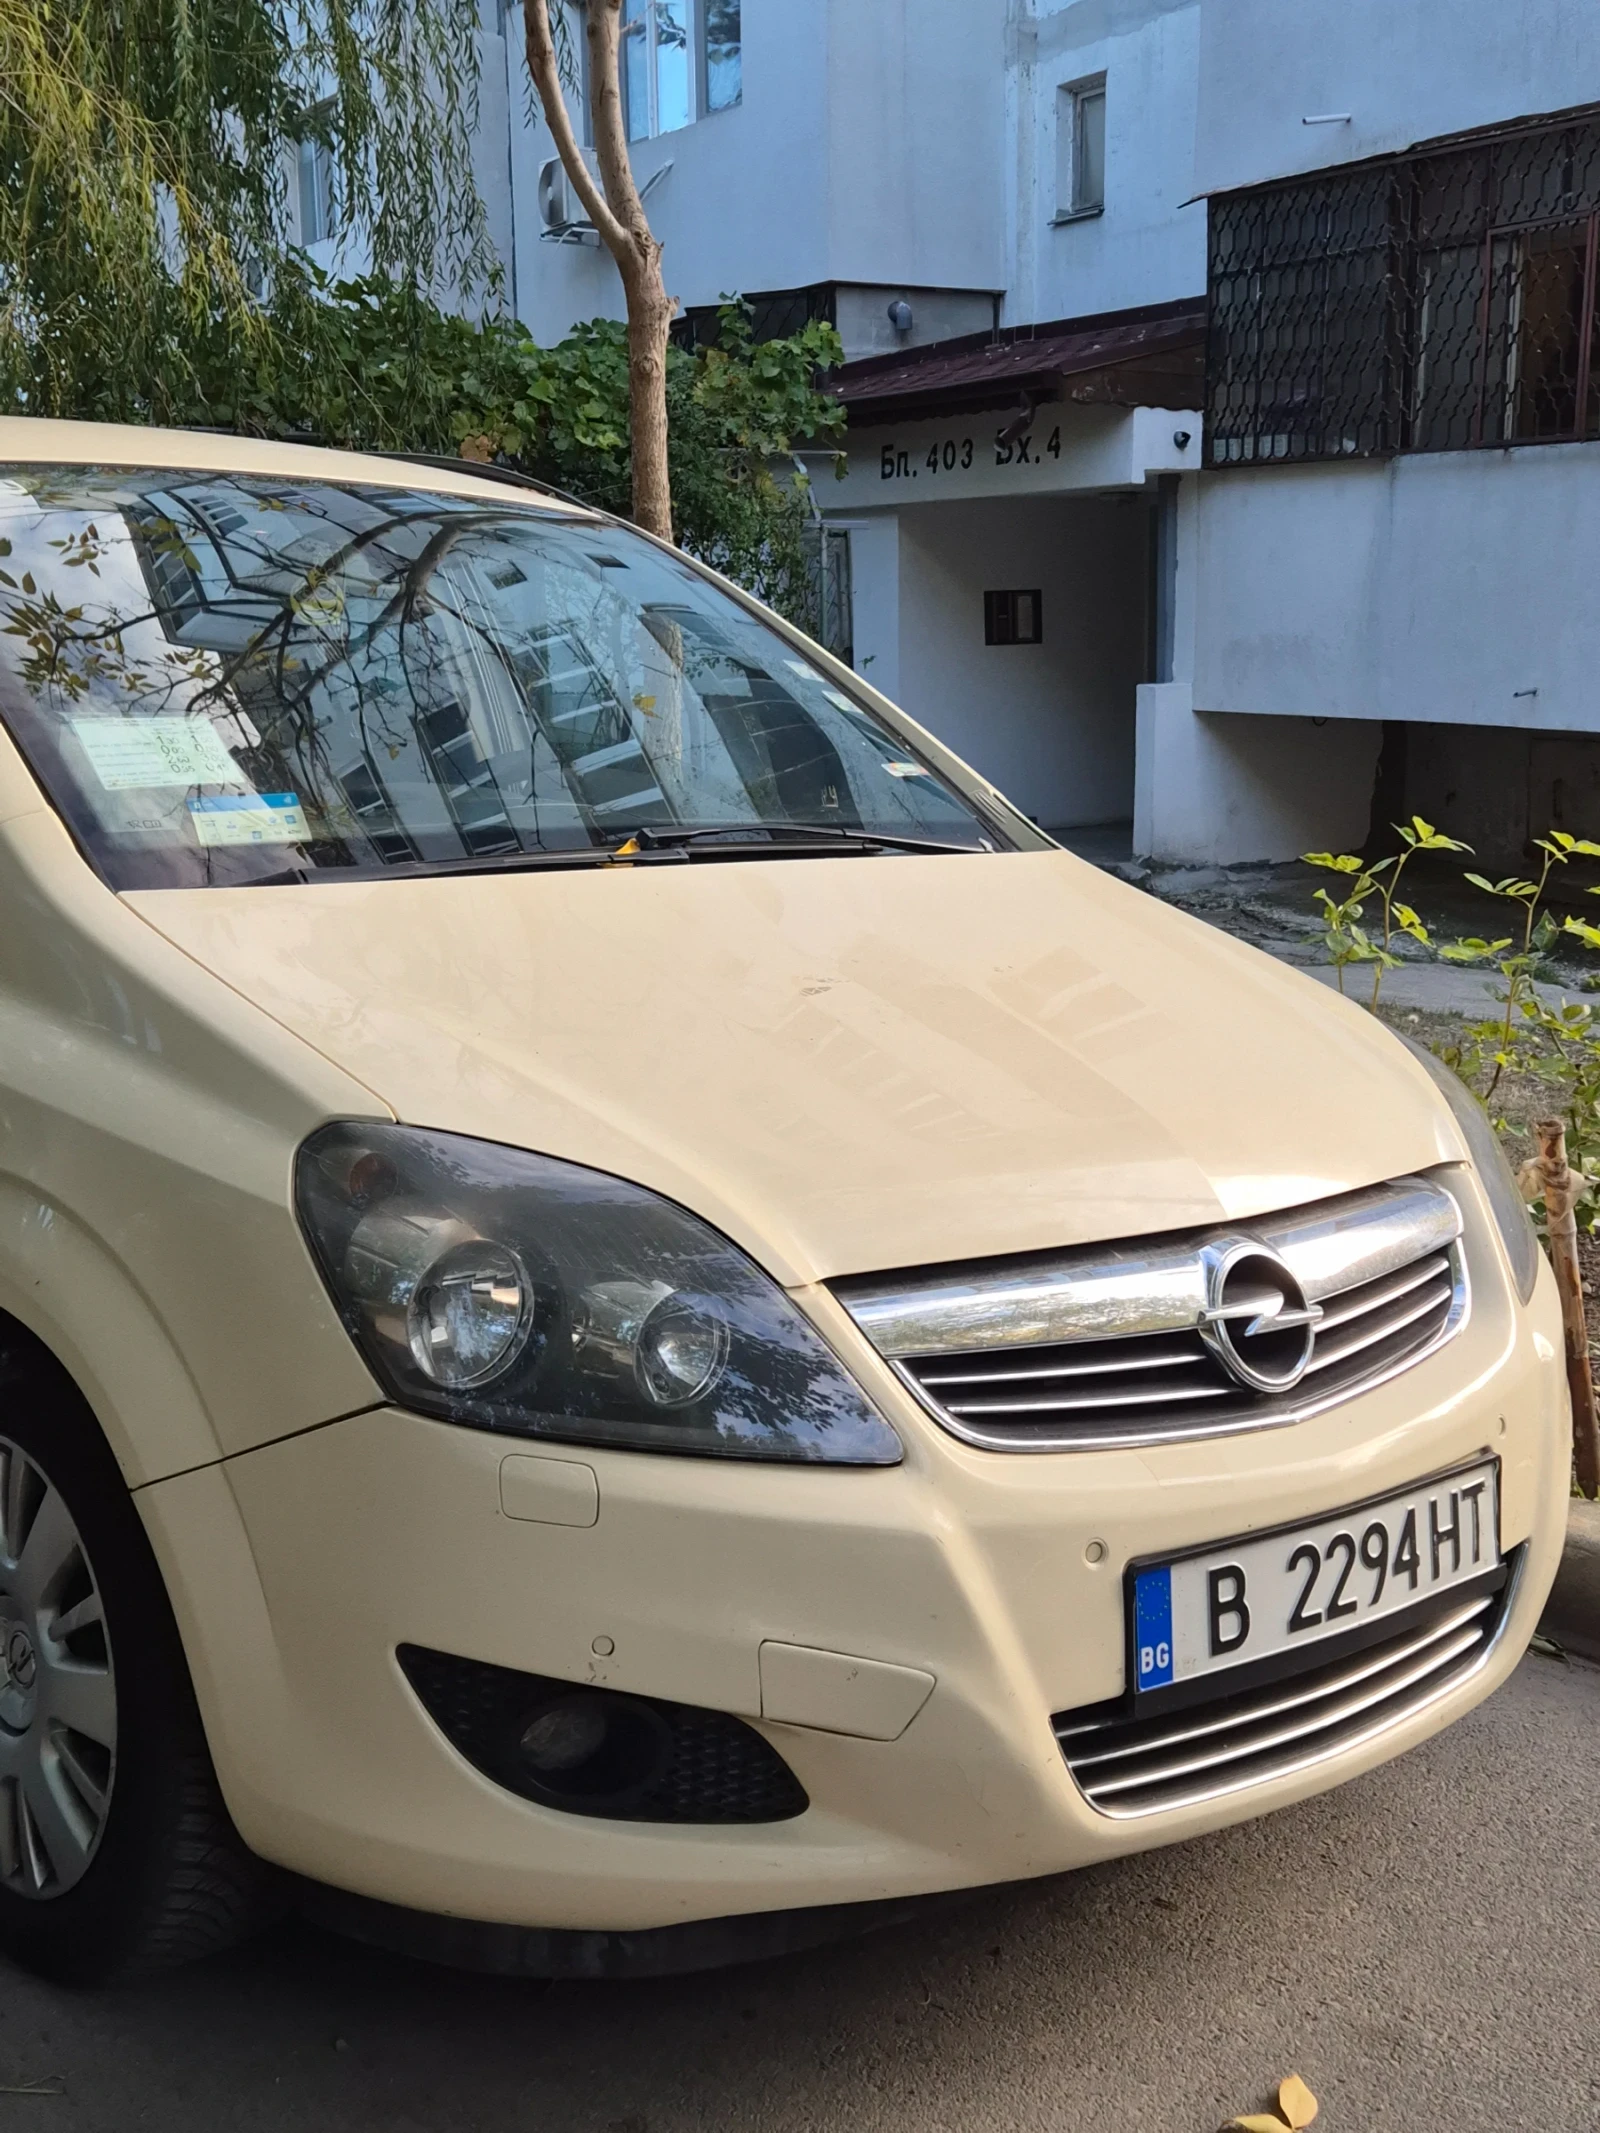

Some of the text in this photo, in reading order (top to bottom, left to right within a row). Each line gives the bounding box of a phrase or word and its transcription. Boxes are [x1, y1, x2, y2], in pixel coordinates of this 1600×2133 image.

[926, 437, 974, 474] 403
[1047, 425, 1061, 459] 4
[1207, 1563, 1251, 1657] B
[1141, 1641, 1169, 1674] BG
